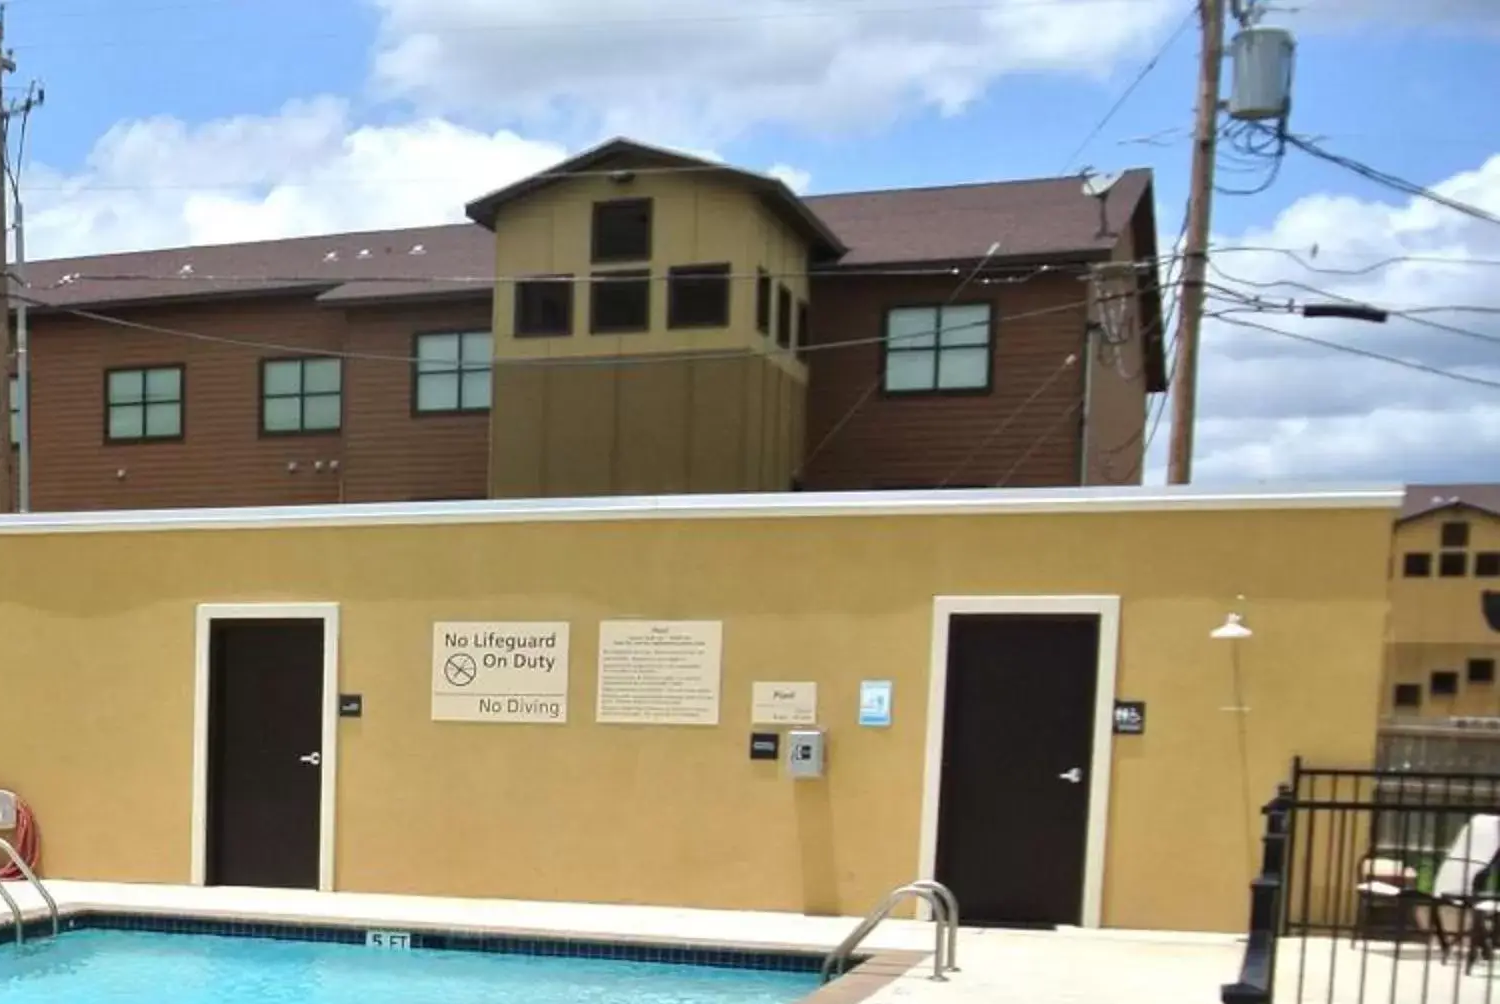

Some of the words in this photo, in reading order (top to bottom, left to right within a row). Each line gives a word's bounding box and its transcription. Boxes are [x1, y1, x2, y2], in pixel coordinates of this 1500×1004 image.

[445, 632, 469, 648] No
[473, 631, 557, 652] Lifeguard
[483, 653, 507, 669] On
[513, 653, 555, 673] Duty
[479, 698, 502, 713] No
[507, 698, 560, 718] Diving
[389, 935, 407, 950] FT
